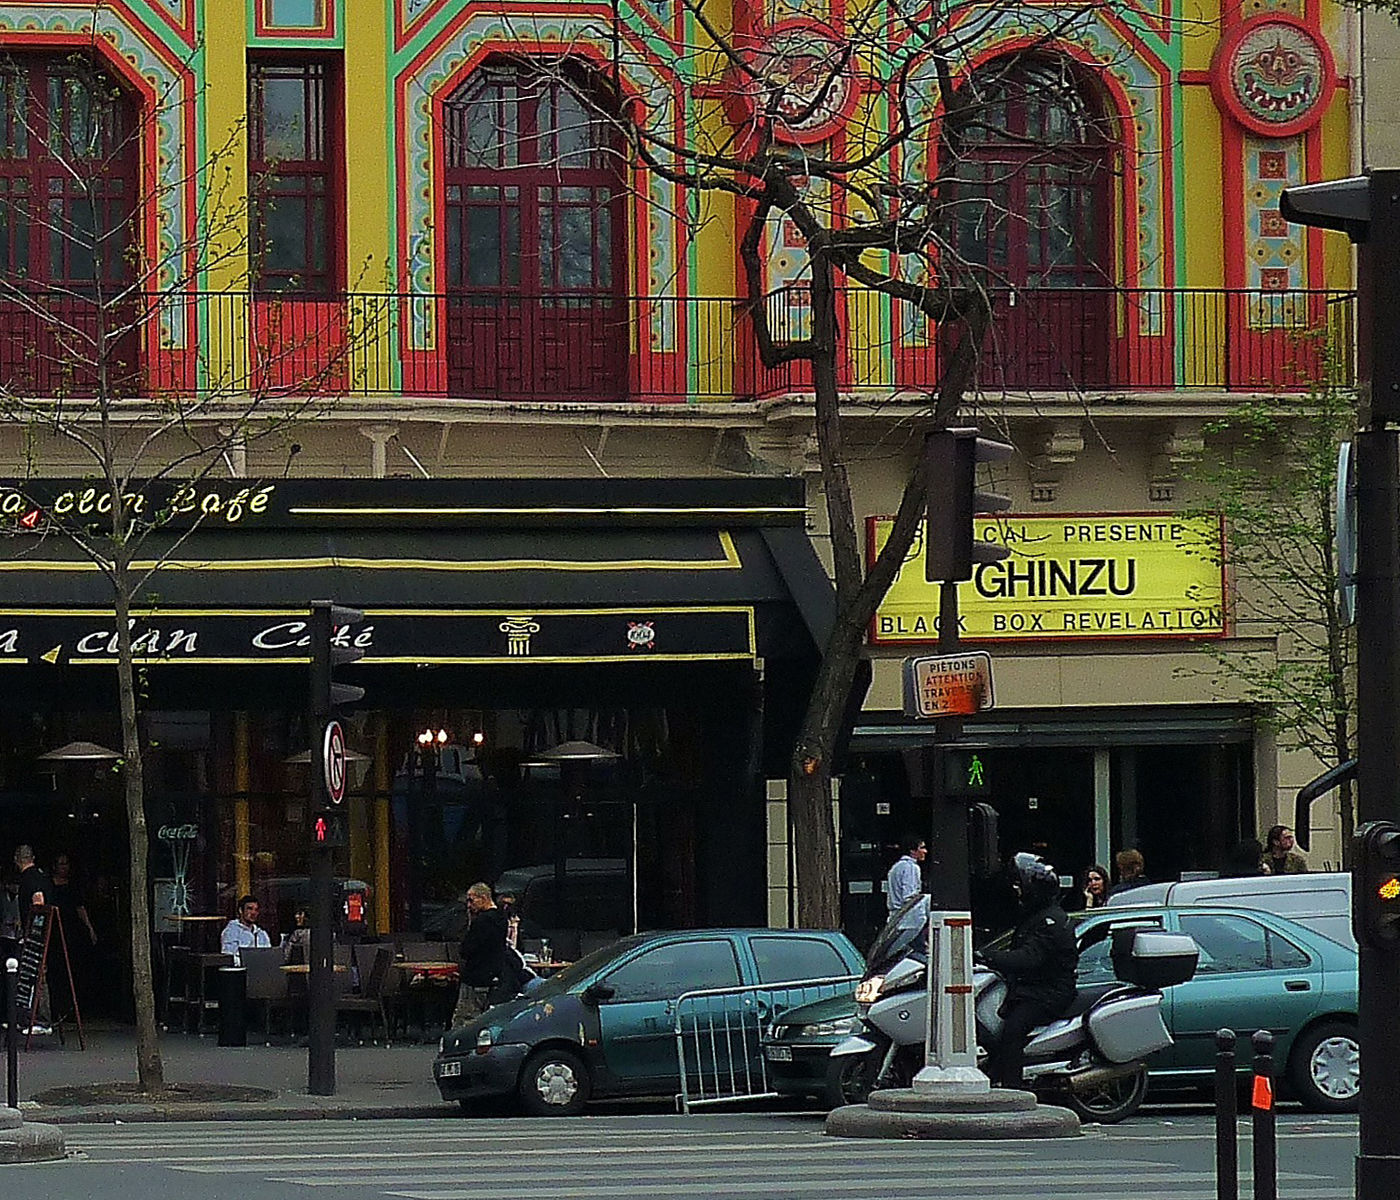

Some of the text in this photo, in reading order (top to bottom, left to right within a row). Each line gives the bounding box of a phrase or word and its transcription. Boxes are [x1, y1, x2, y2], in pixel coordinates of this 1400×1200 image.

[1064, 522, 1183, 542] PRESENTE
[974, 558, 1136, 598] GHINZU
[993, 613, 1044, 631] BOX
[1062, 609, 1223, 632] REVELATION
